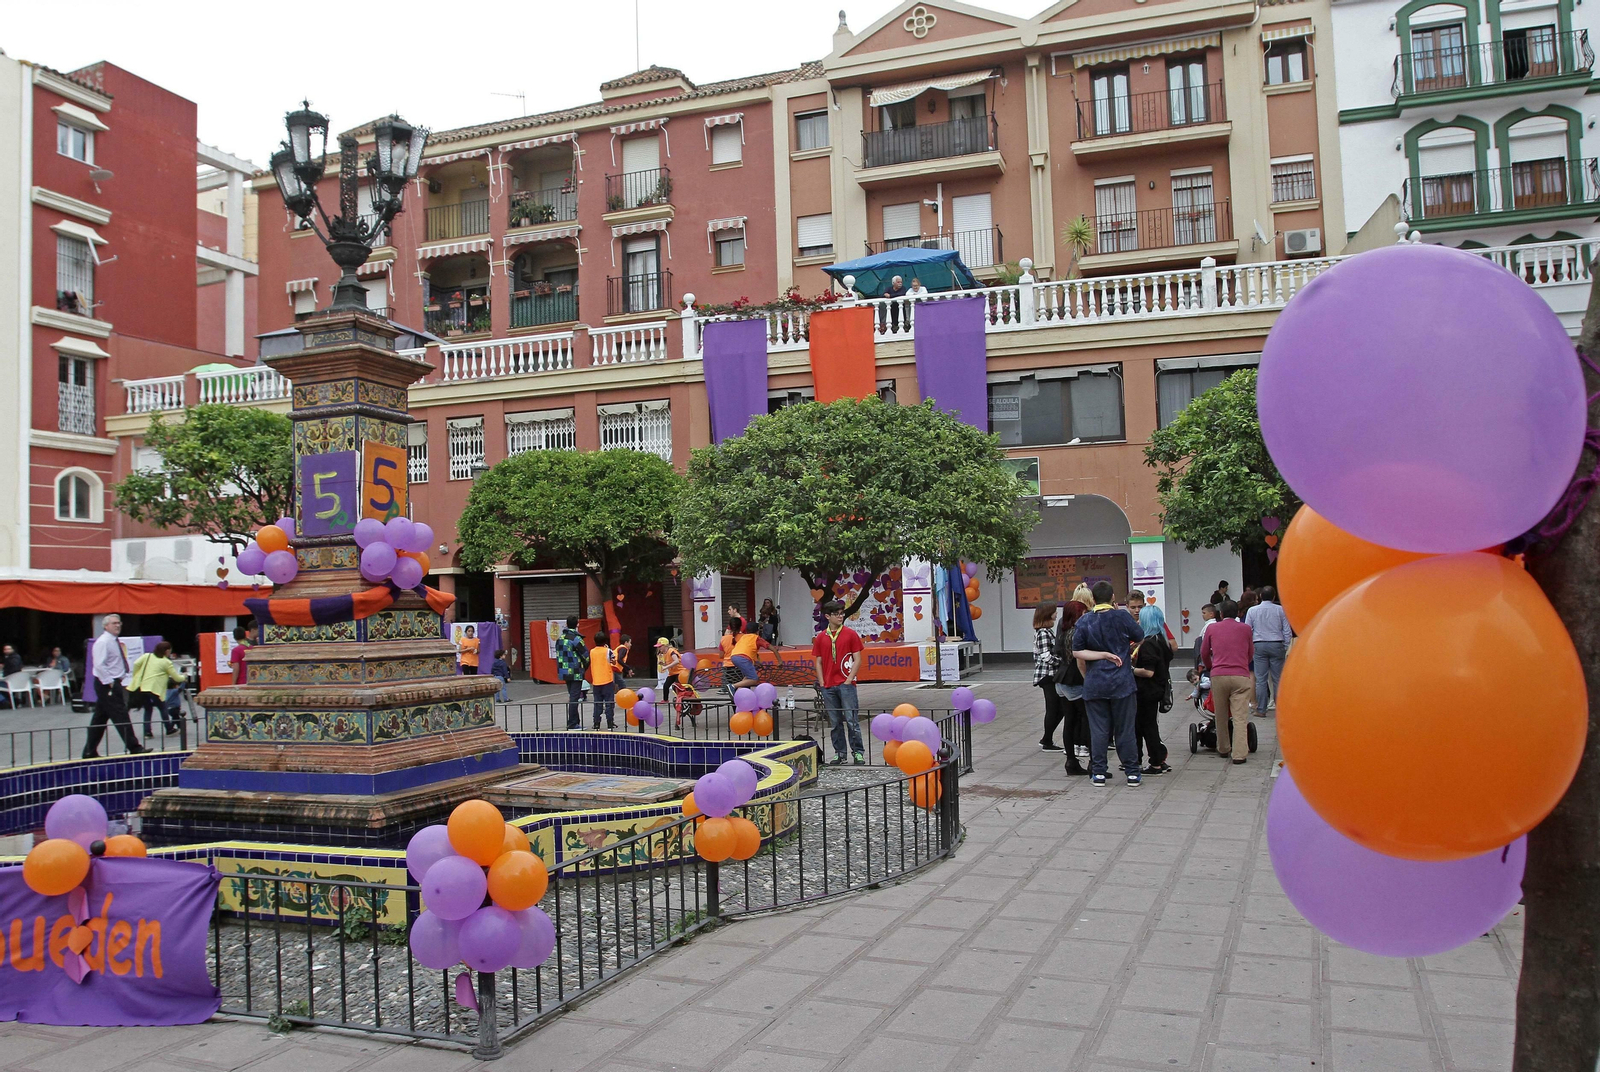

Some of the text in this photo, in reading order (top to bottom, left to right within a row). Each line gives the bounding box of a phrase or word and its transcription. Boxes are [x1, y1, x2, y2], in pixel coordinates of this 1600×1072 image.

[313, 457, 397, 519] 5 5
[868, 652, 912, 671] pueden
[0, 892, 163, 979] ueden
